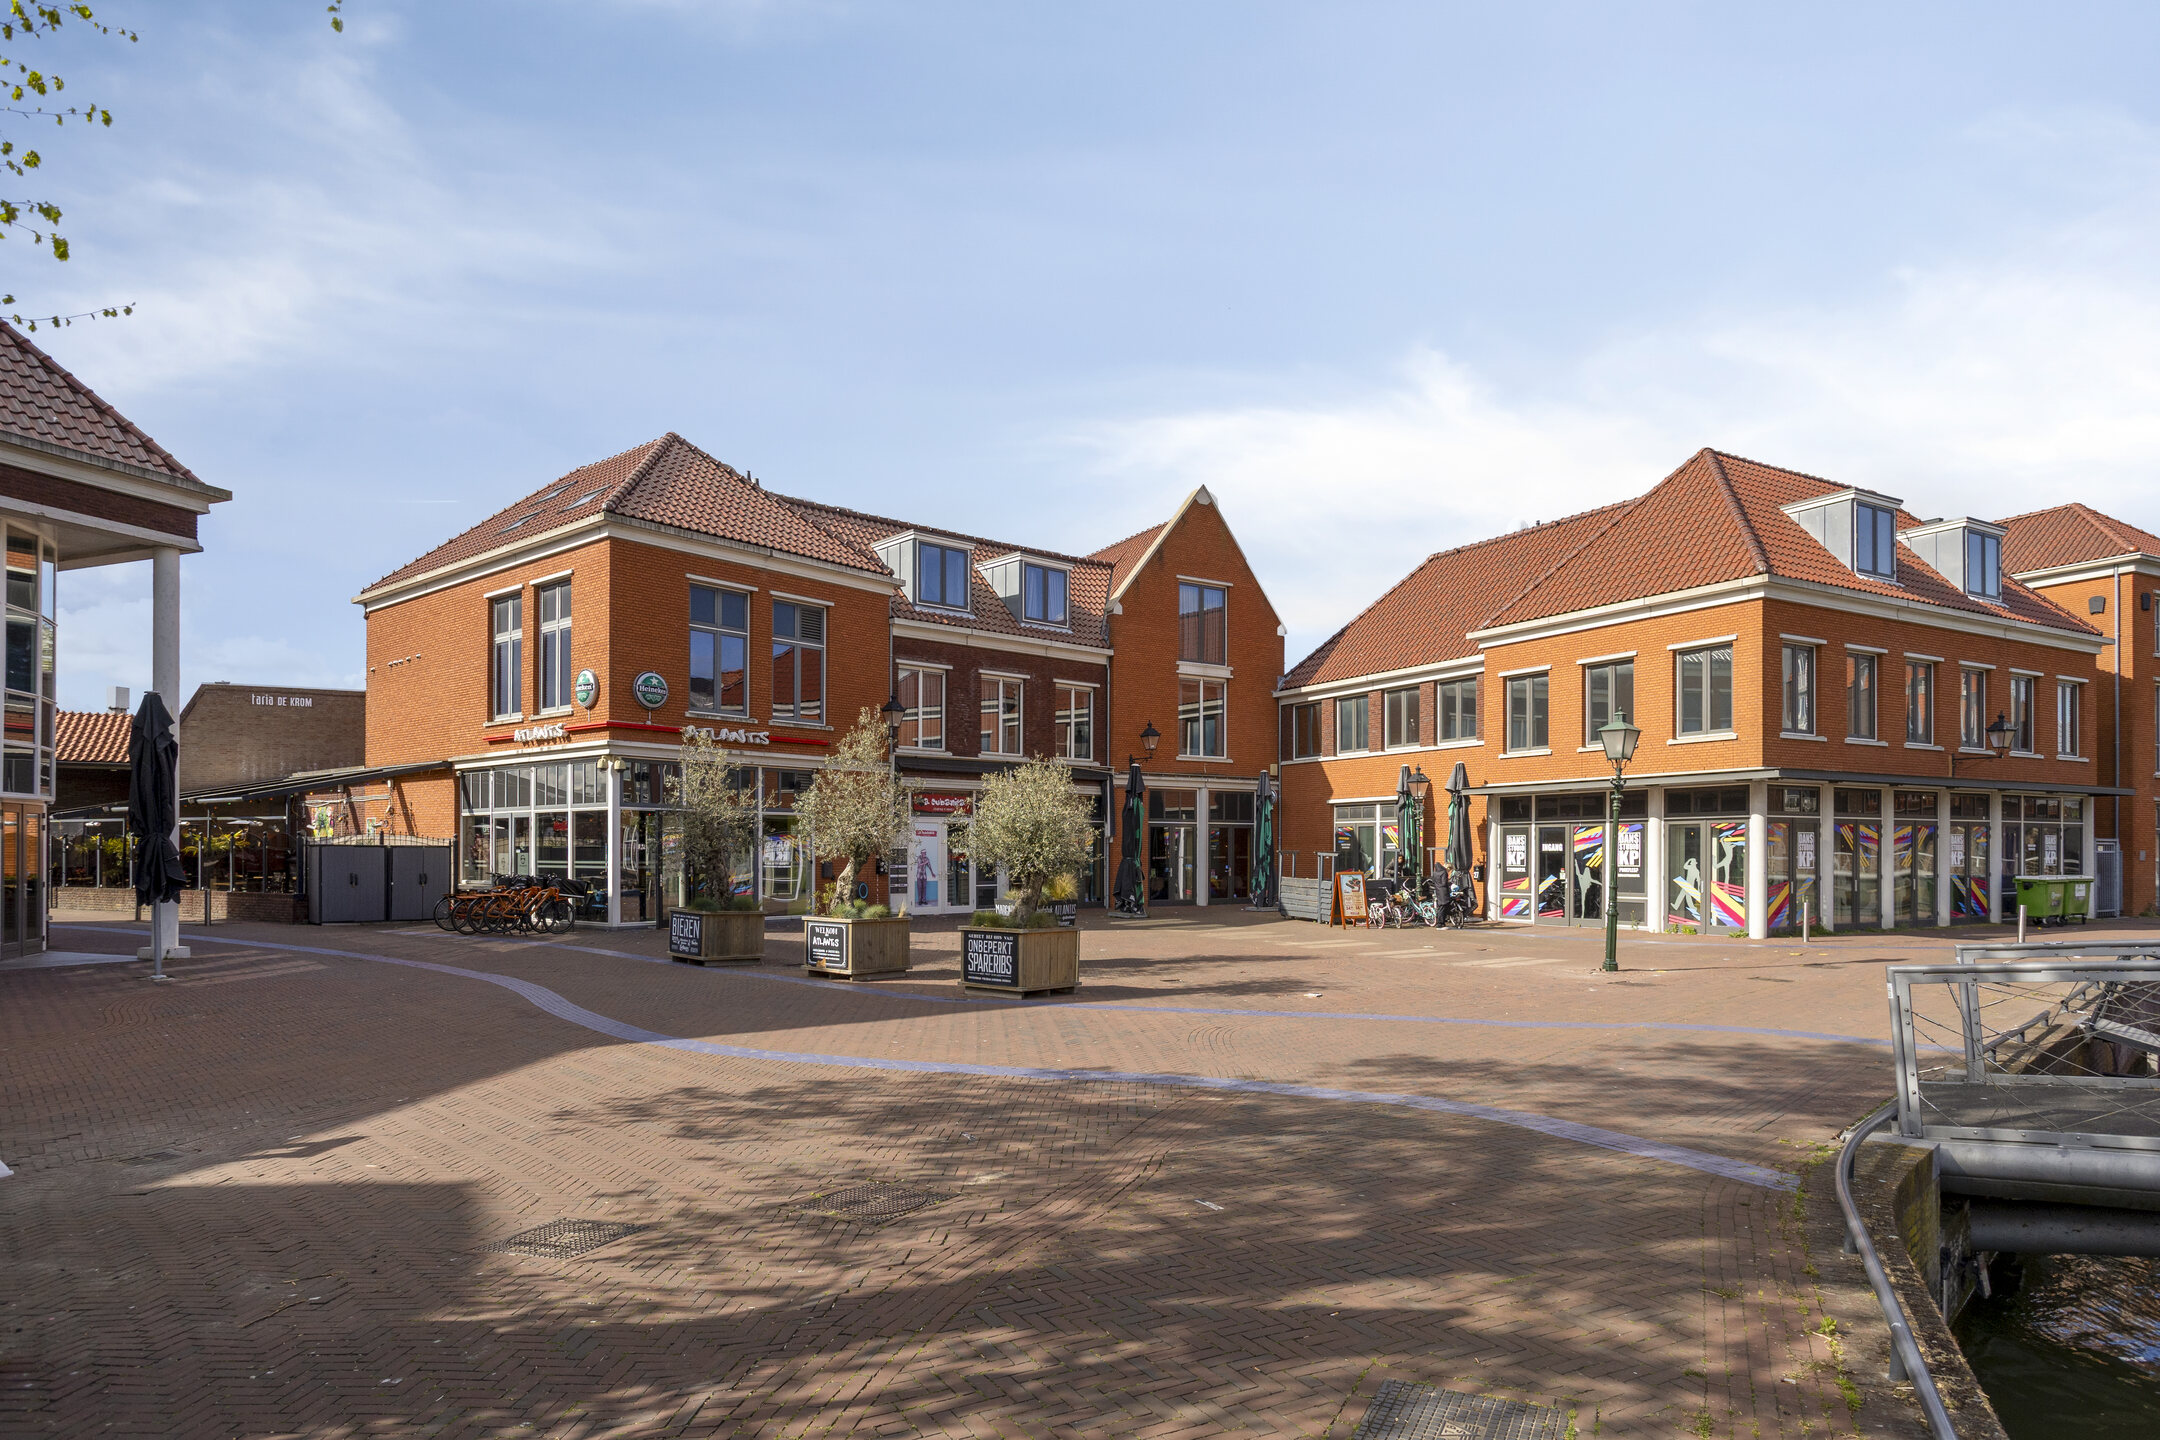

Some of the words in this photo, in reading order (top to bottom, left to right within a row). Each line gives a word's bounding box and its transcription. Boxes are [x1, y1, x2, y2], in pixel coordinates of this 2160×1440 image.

[640, 685, 666, 695] Heineken
[277, 696, 287, 706] DE
[290, 697, 313, 707] KROM
[1542, 844, 1563, 852] INGANG
[1507, 851, 1526, 865] KP
[1619, 850, 1639, 865] KP
[1799, 851, 1814, 867] KP
[1952, 851, 1964, 865] KP
[672, 917, 700, 938] BIEREN
[815, 927, 838, 935] WELKOM
[968, 940, 1013, 955] ONBEPERKT
[968, 952, 1012, 974] SPARERIBS
